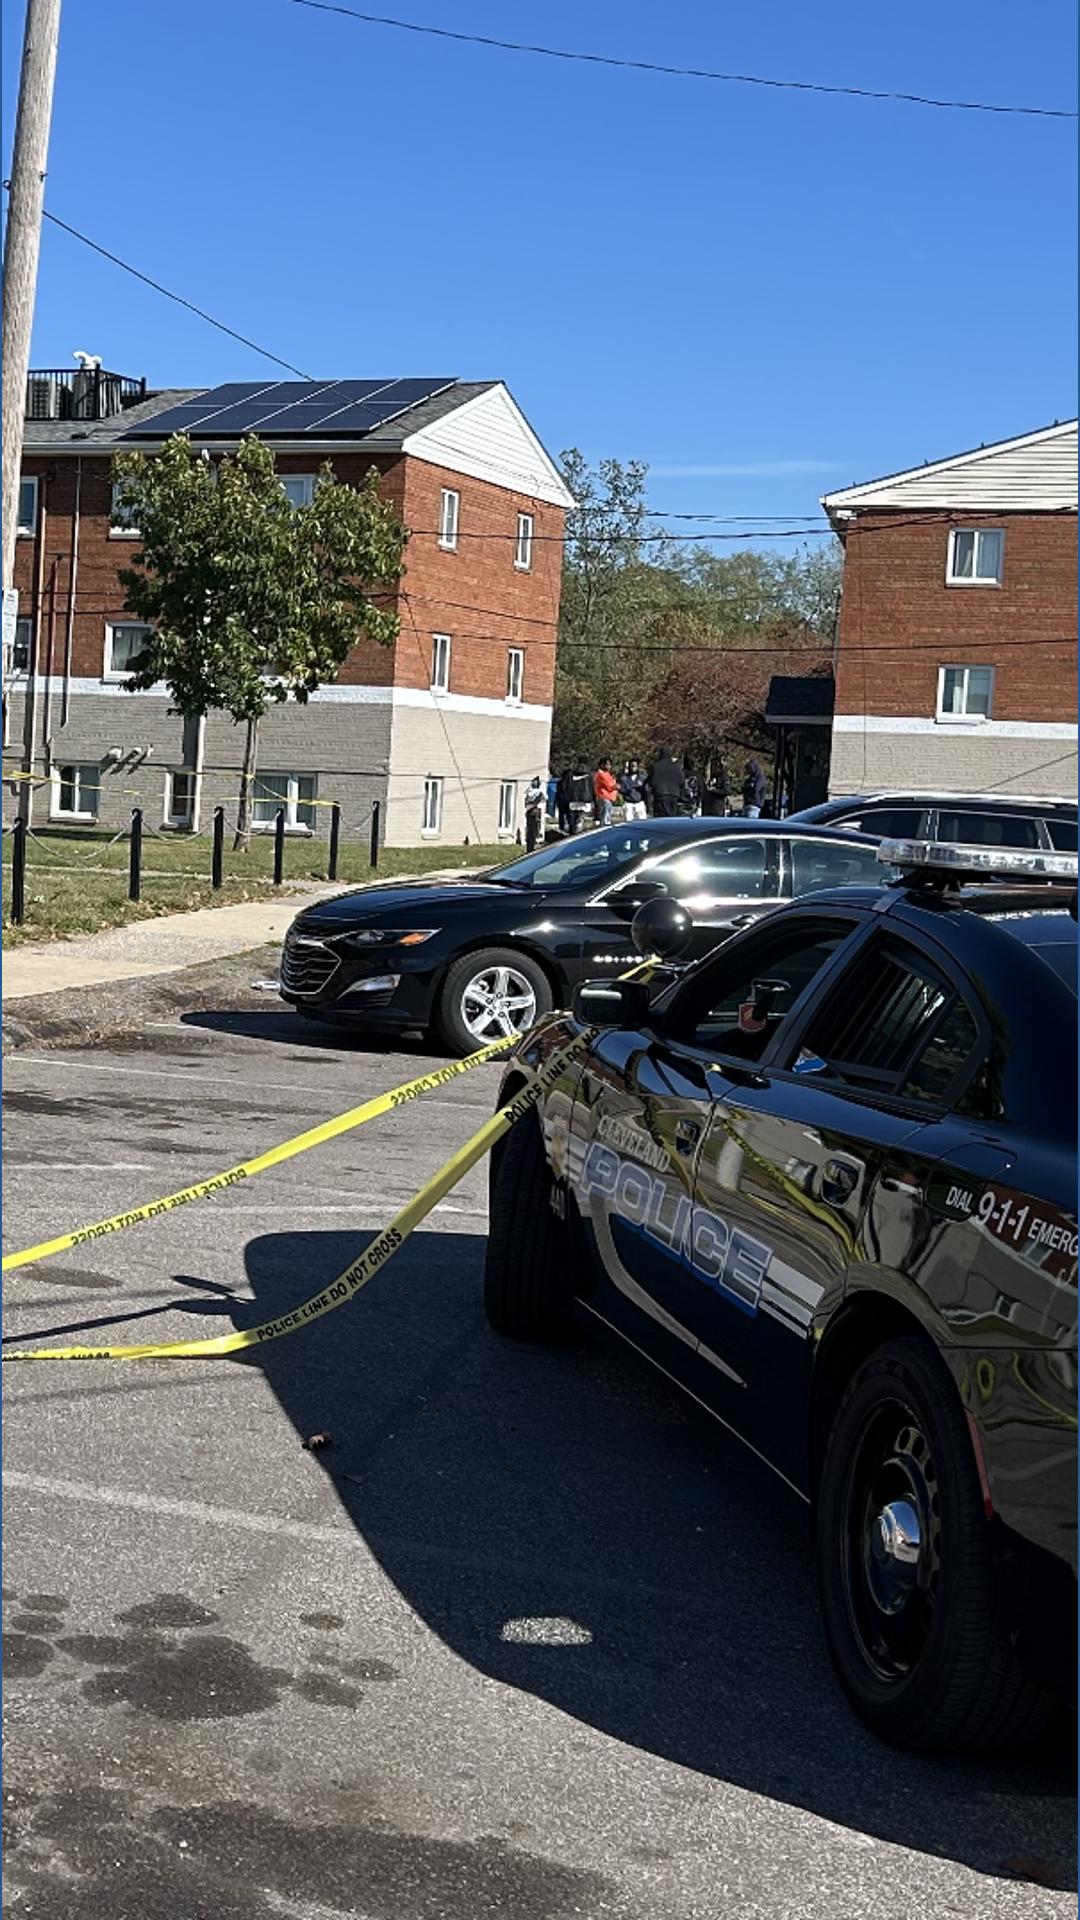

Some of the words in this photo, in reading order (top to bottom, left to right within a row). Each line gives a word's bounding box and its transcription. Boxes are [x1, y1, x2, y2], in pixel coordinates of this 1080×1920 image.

[504, 1083, 541, 1124] POLICE
[541, 1060, 566, 1087] LINE
[566, 1045, 581, 1062] DO
[582, 1027, 600, 1044] NO
[598, 1115, 671, 1173] CLEVELAND
[580, 1141, 773, 1312] POLICE
[945, 1186, 973, 1213] DIAL
[979, 1191, 1031, 1241] 9-1-1
[256, 1313, 301, 1341] POLICE
[302, 1295, 330, 1317] LINE
[329, 1282, 348, 1300] DO
[346, 1260, 369, 1289] NOT
[368, 1228, 402, 1266] CROSS
